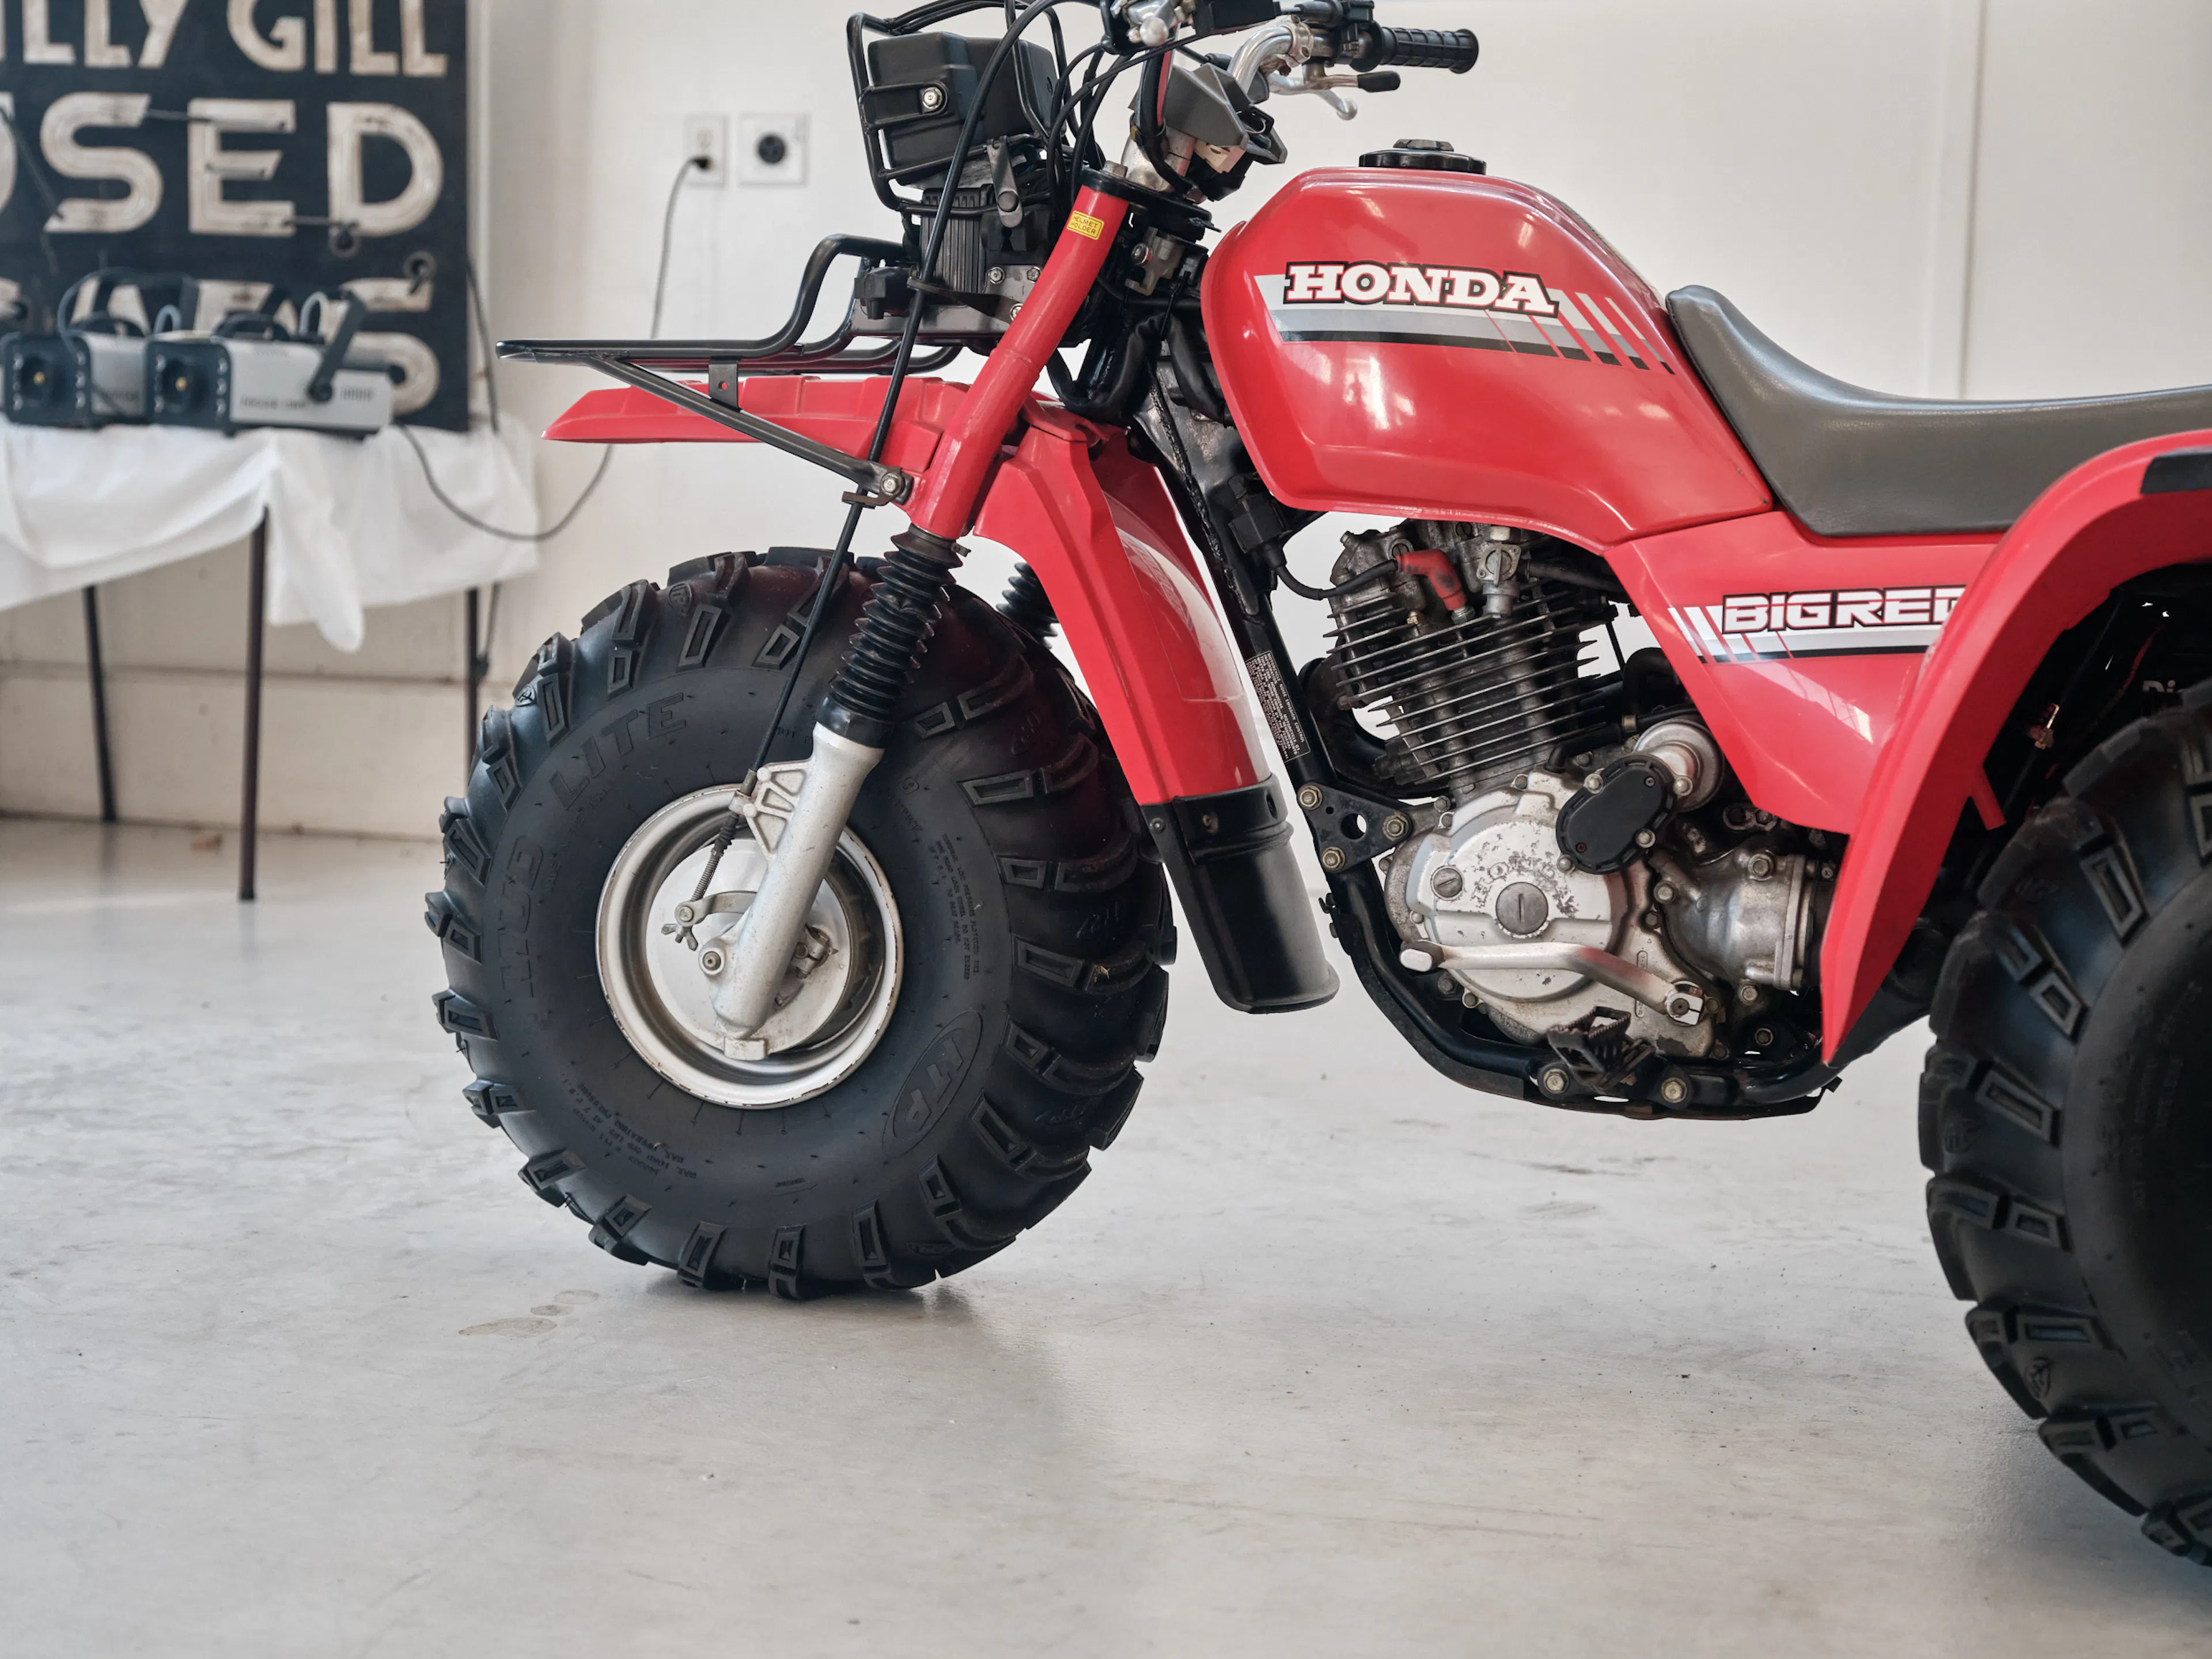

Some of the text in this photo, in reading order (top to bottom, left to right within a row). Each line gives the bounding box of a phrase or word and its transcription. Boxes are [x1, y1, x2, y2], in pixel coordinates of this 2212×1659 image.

[0, 92, 443, 236] SED
[1071, 222, 1096, 234] HOLDER
[1074, 216, 1098, 228] HELMET
[1285, 263, 1558, 316] HONDA
[548, 692, 687, 811] LITE
[1294, 721, 1305, 743] CONTROL
[906, 1037, 963, 1133] ITP
